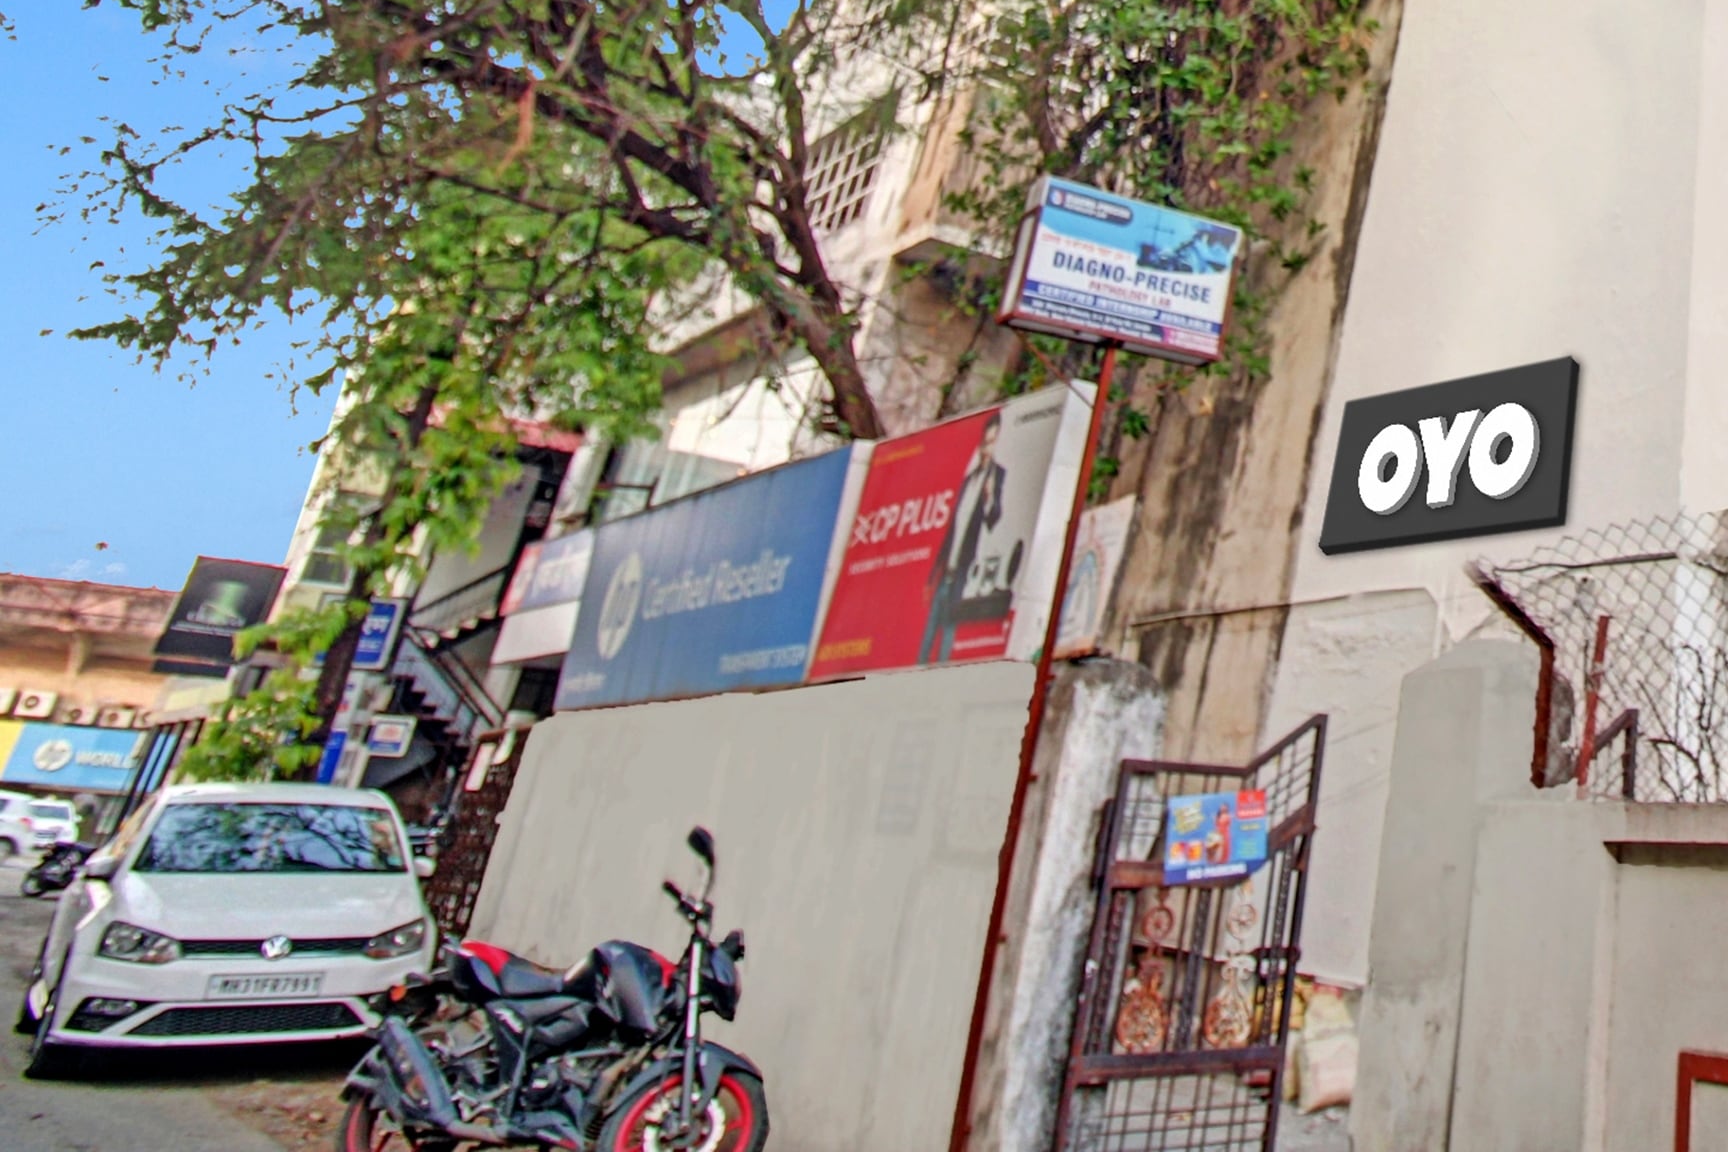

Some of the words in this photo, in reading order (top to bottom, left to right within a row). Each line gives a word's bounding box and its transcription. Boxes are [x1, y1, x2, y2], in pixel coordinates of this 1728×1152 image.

[1053, 250, 1212, 304] DIAGNO-PRECISE
[1358, 402, 1541, 516] OYO
[870, 503, 900, 544] CP
[896, 489, 954, 538] PLUS
[711, 549, 792, 605] Reseller
